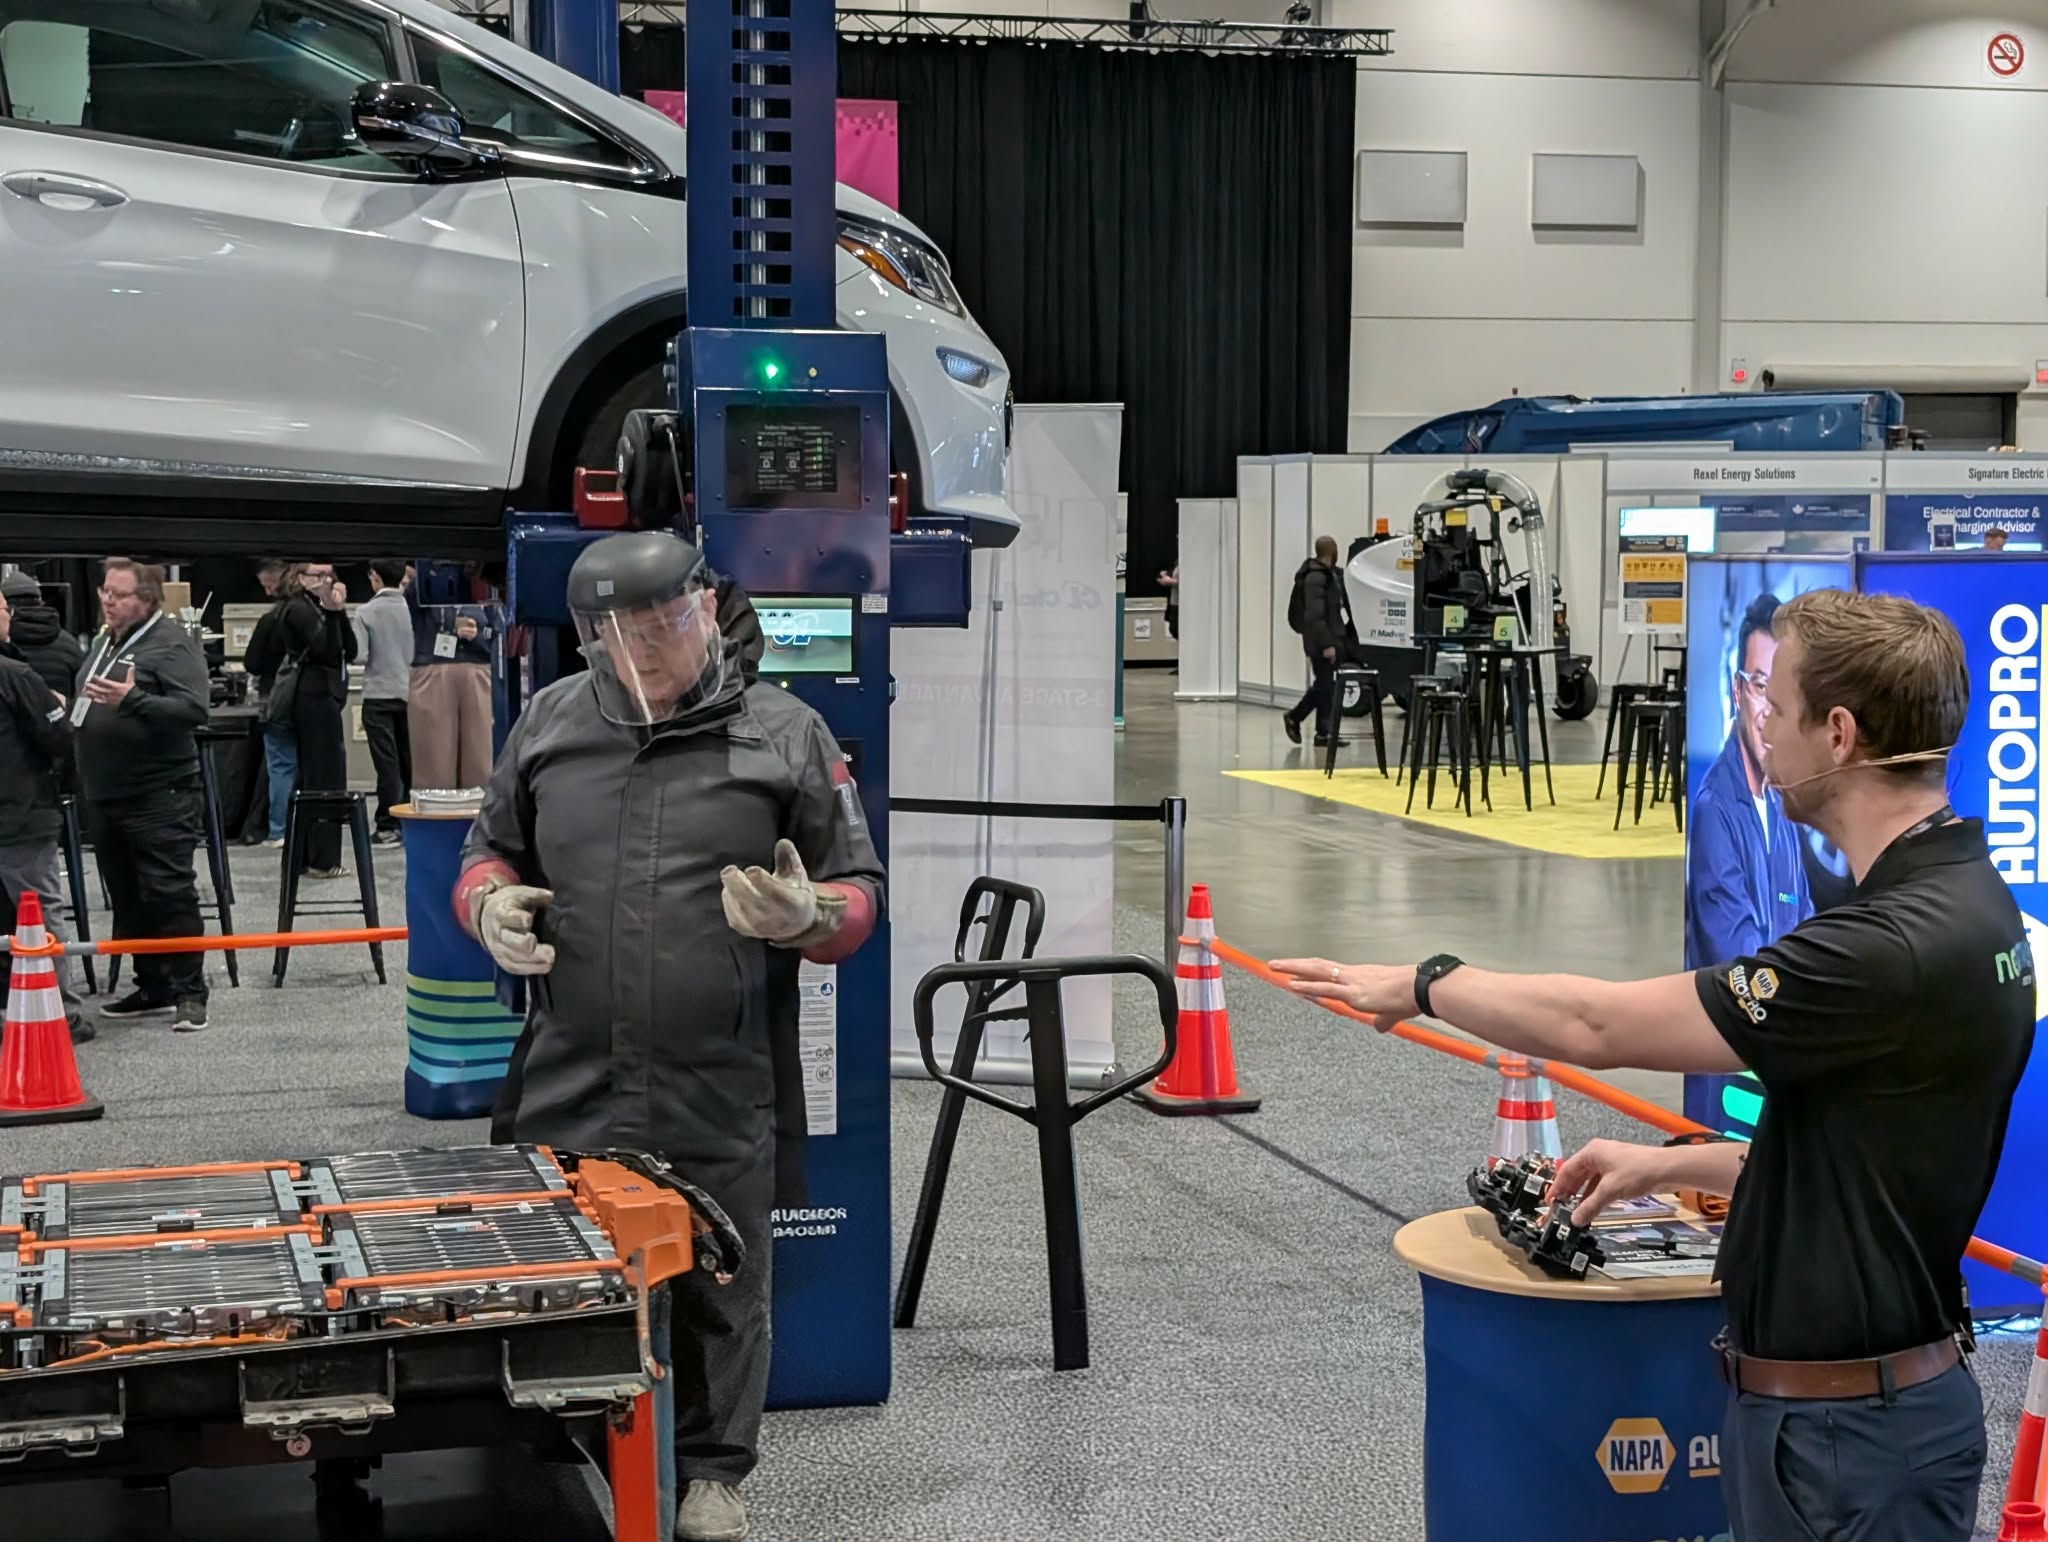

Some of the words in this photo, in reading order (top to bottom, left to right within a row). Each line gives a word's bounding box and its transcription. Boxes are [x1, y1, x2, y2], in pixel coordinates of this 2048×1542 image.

[1693, 467, 1718, 480] Rexel
[1721, 467, 1752, 482] Energy
[1754, 467, 1796, 480] Solutions
[1968, 467, 2009, 481] Signature
[2012, 467, 2045, 479] Electric
[1973, 506, 2029, 519] Contractor
[2031, 506, 2041, 519] &
[1996, 520, 2036, 533] Advisor
[1987, 603, 2039, 885] AUTOPRO
[1610, 1438, 1664, 1472] NAPA
